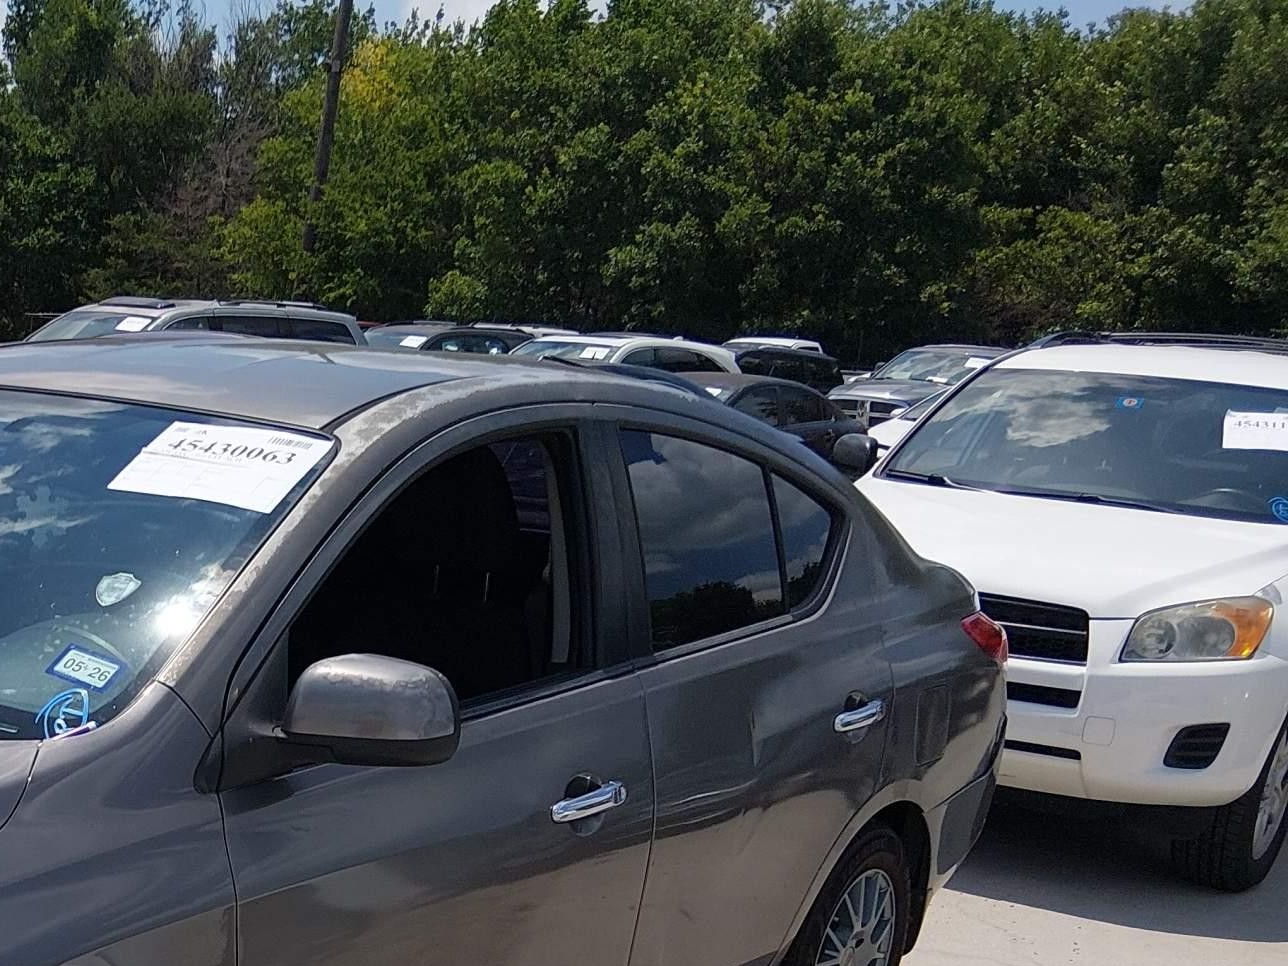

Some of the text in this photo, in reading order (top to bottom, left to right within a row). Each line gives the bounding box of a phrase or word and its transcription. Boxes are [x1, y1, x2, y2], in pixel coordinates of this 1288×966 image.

[167, 437, 296, 465] 45430063
[63, 657, 111, 682] 05 26
